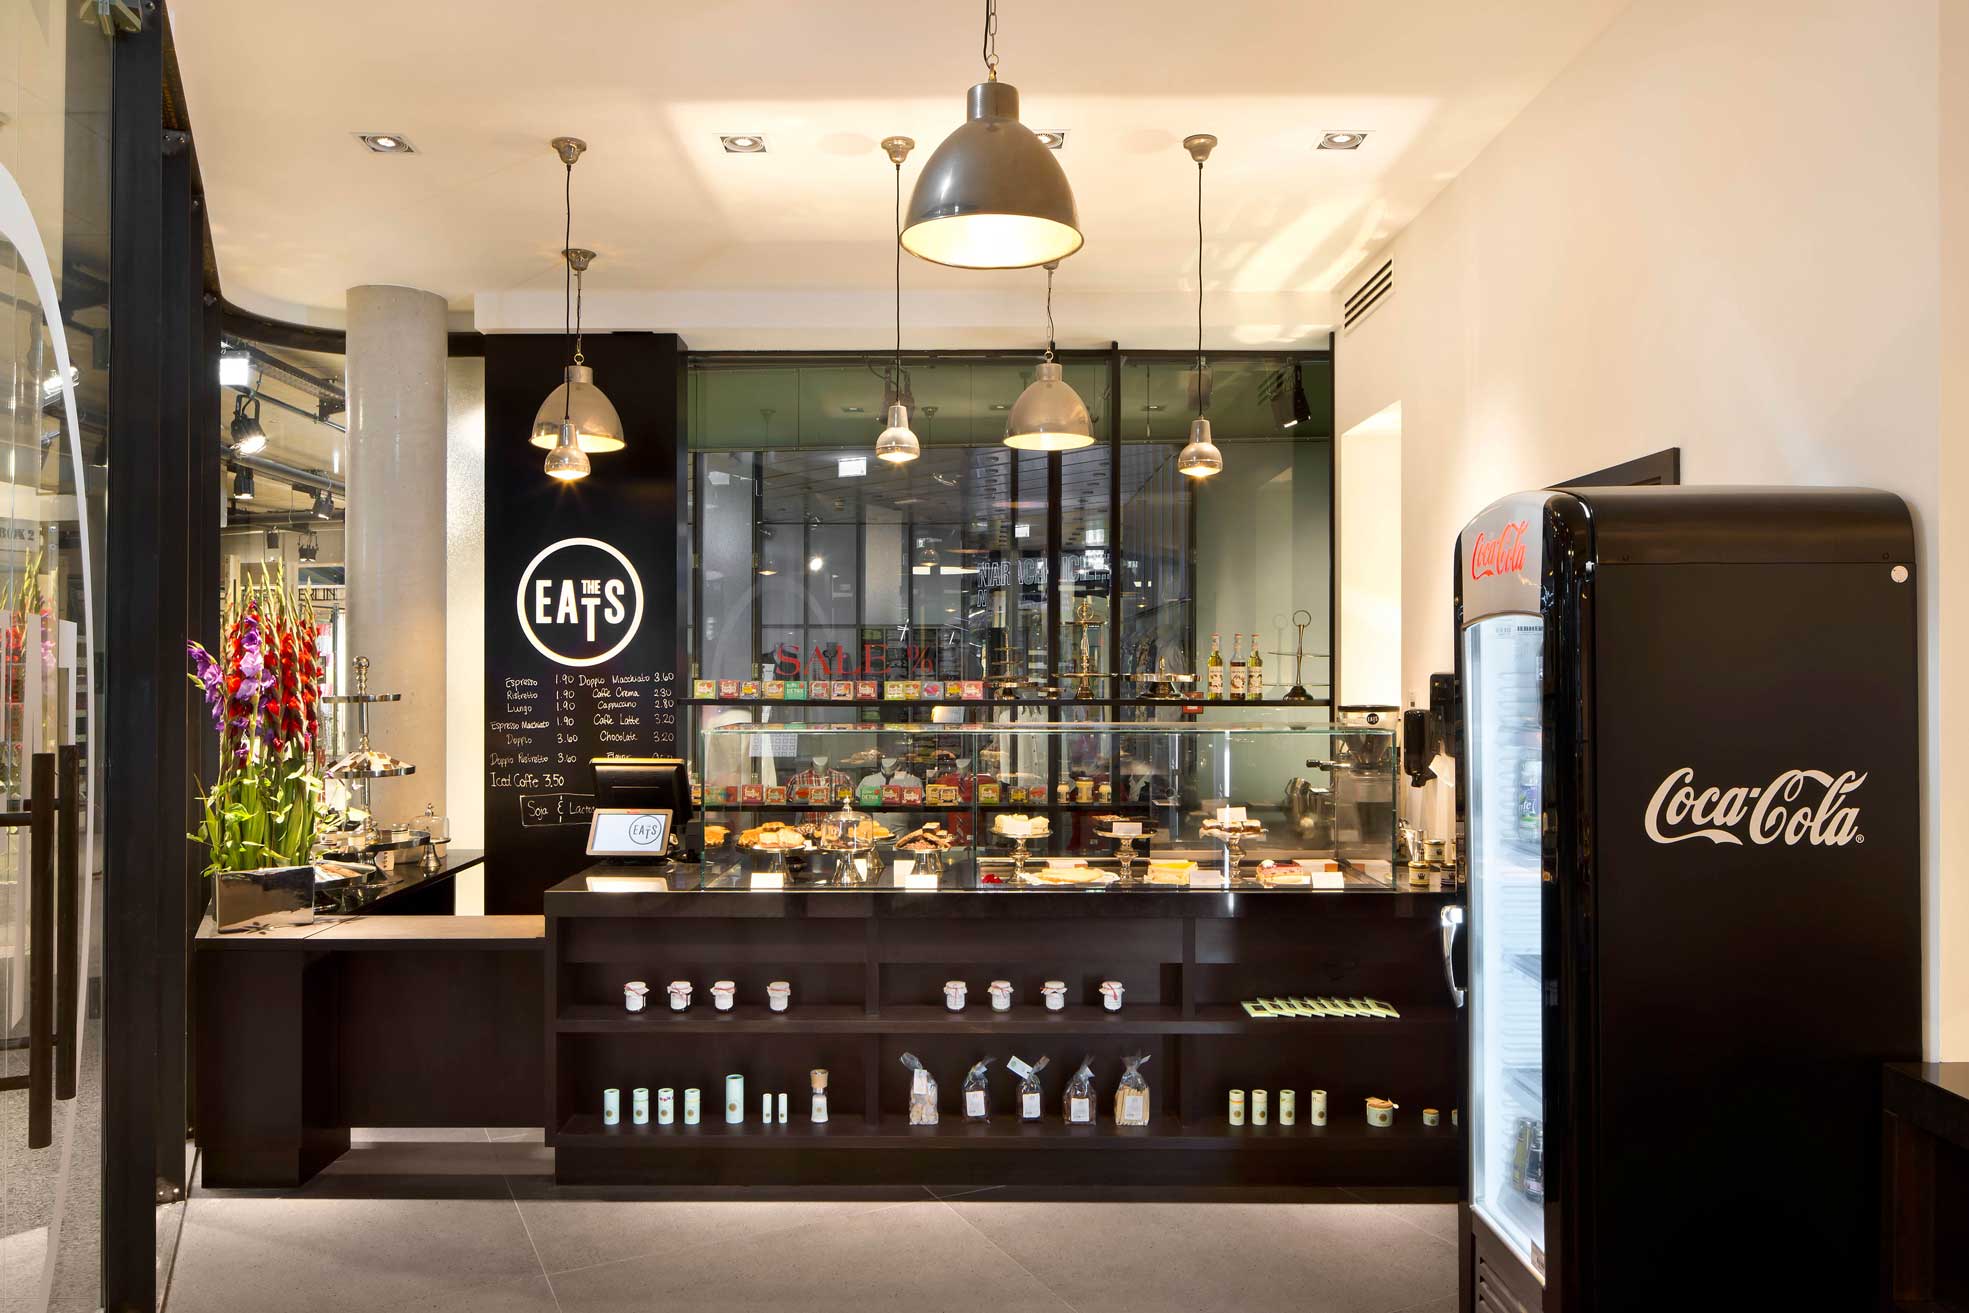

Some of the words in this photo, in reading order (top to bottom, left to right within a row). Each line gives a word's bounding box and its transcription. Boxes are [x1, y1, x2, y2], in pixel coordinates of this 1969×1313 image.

[1471, 520, 1529, 581] Coca-Cola
[581, 579, 601, 595] THE
[535, 578, 625, 642] EATS
[775, 643, 891, 675] SALE
[505, 677, 538, 692] Espresso
[555, 674, 575, 685] 1.90
[579, 674, 605, 687] Doppio
[654, 672, 675, 683] 3.60
[506, 690, 538, 700] Ristretto
[556, 689, 575, 700] 1.90
[615, 686, 640, 698] Crema
[507, 703, 533, 716] Lungo
[556, 700, 576, 712] 1.90
[654, 698, 675, 709] 2.80
[490, 721, 520, 733] Espresso
[556, 715, 575, 727] 1.90
[620, 713, 640, 725] Latte
[654, 713, 675, 725] 3.20
[506, 733, 533, 747] Doppio
[556, 733, 579, 744] 3.60
[653, 731, 675, 743] 3.20
[490, 752, 514, 768] Doppio
[557, 752, 577, 764] 3.60
[490, 771, 512, 787] Iced
[513, 773, 539, 788] Coffe
[542, 773, 565, 788] 3.50
[527, 800, 549, 821] Soja
[1644, 767, 1868, 846] Coca-Cola
